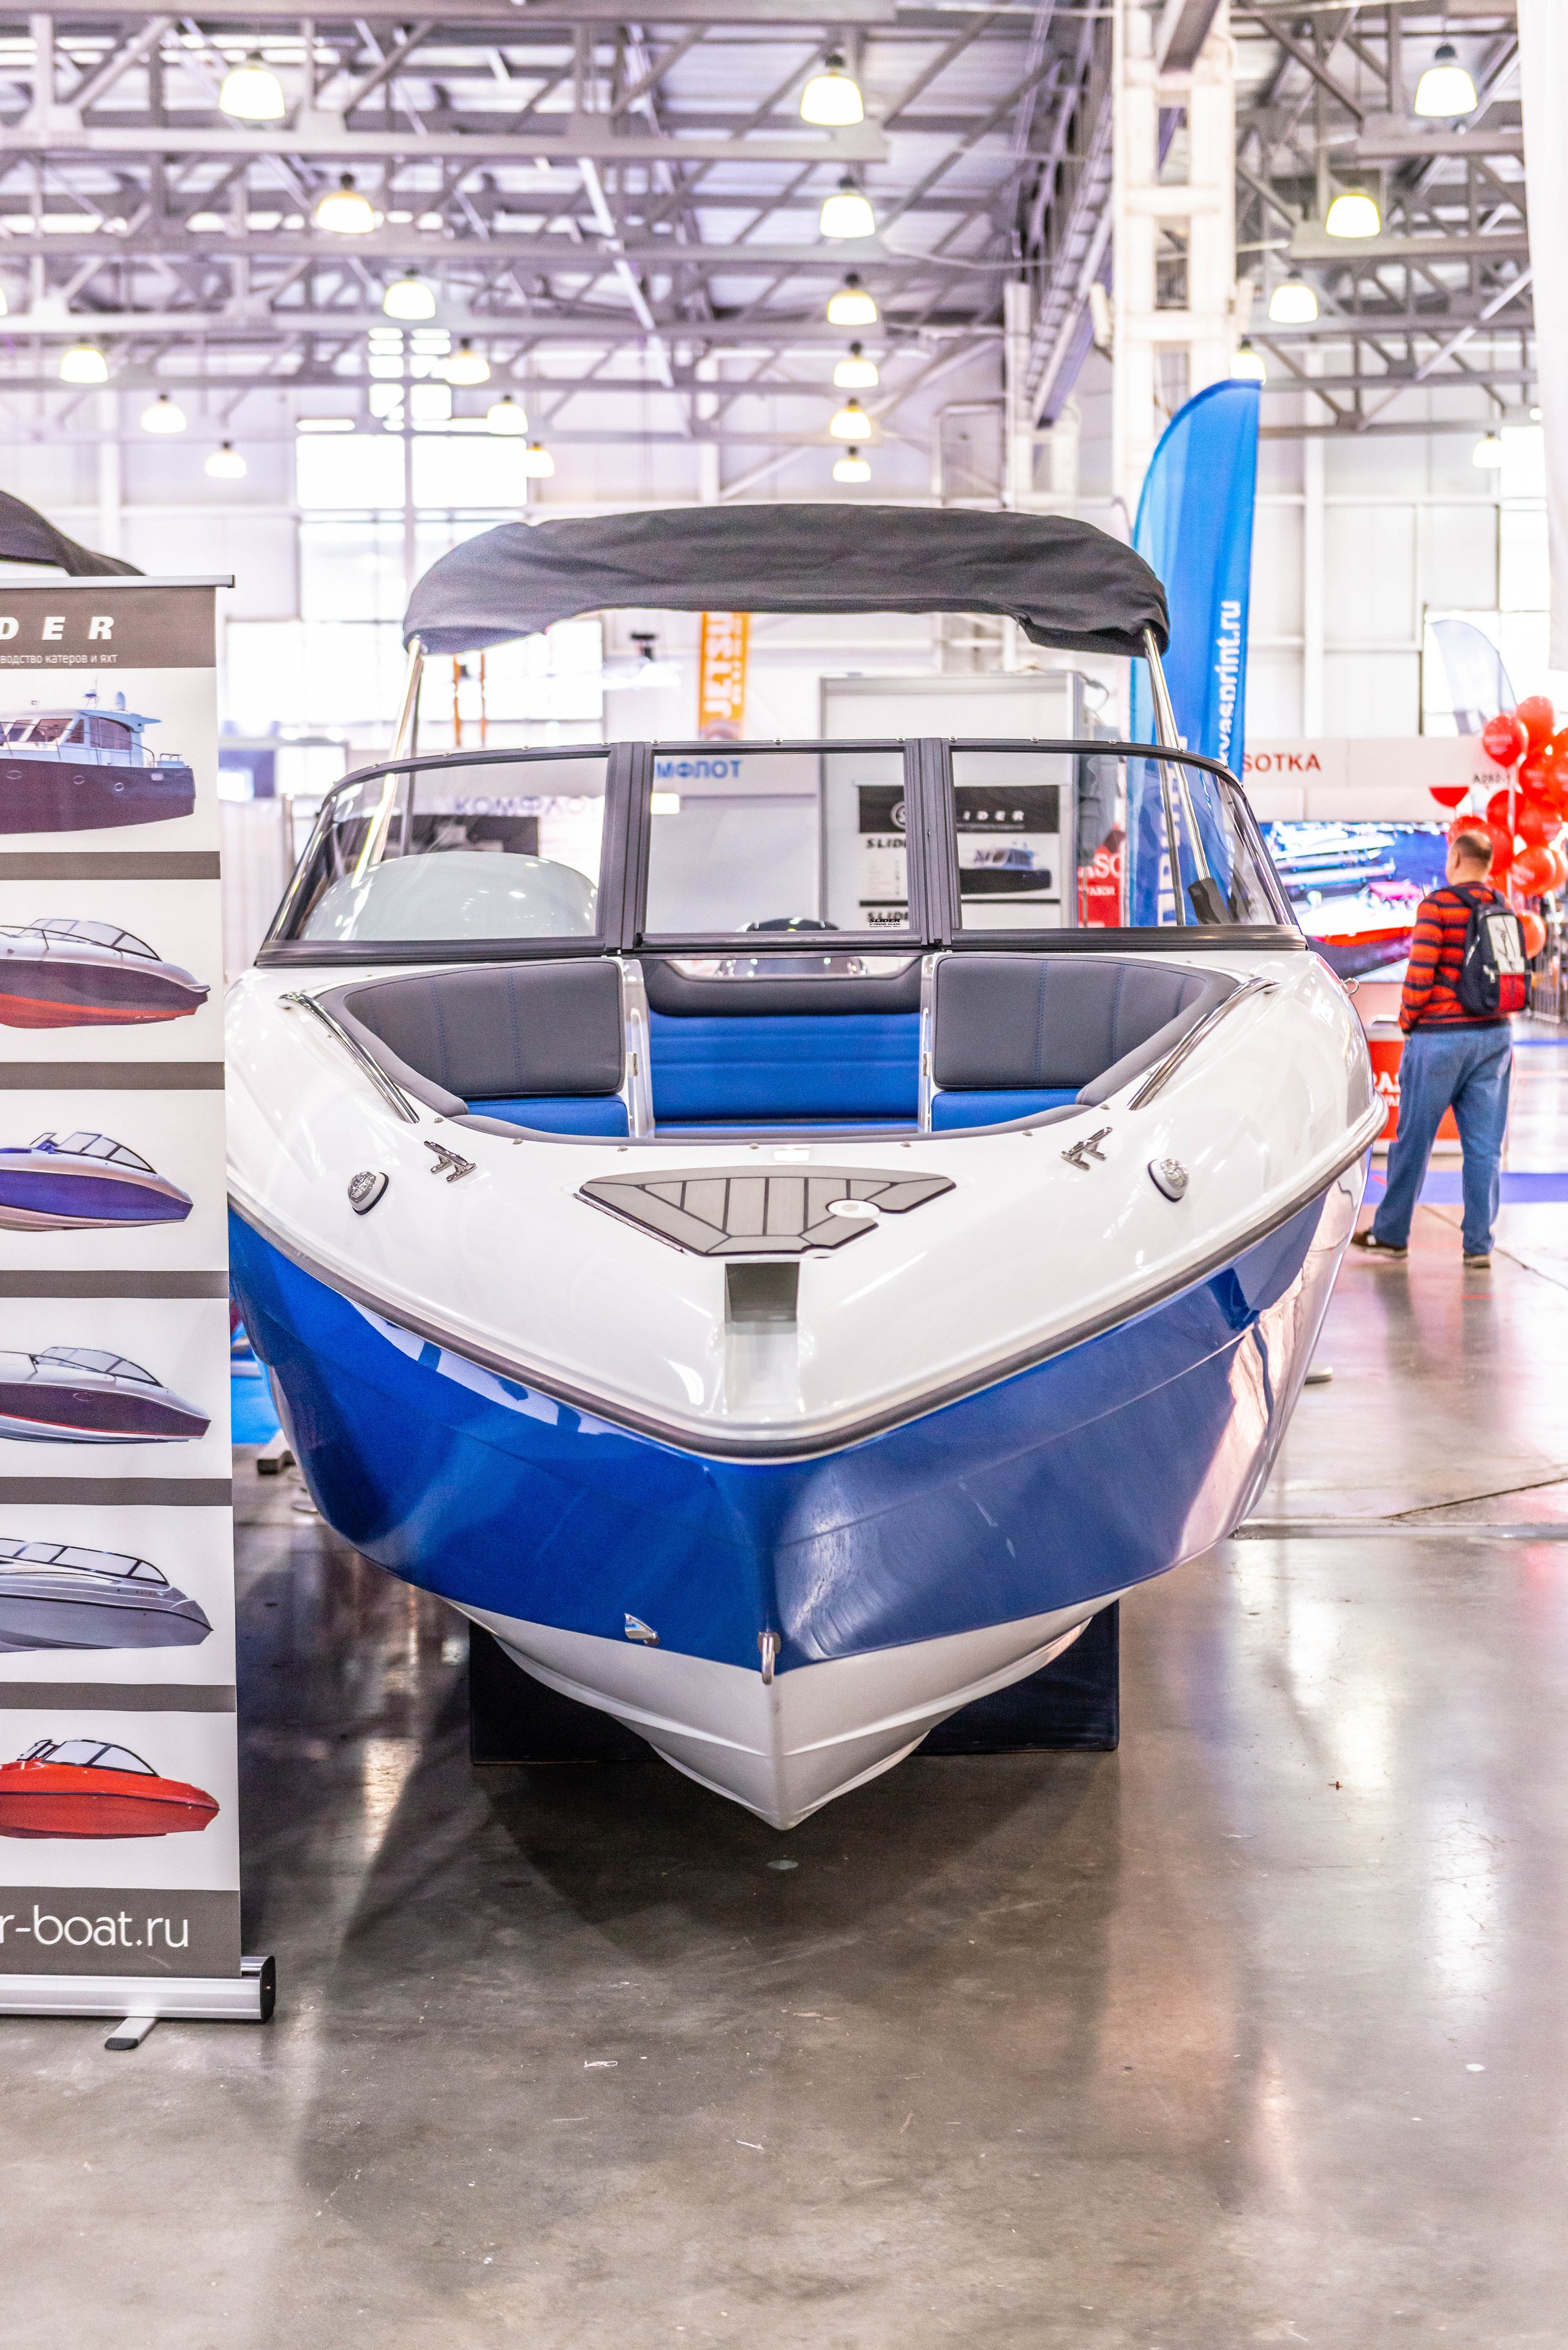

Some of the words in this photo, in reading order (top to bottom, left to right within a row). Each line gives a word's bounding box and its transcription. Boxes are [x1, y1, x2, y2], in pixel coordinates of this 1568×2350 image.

[0, 616, 115, 640] DER
[1, 654, 43, 665] водство
[45, 654, 88, 666] катеров
[91, 654, 97, 663] и
[100, 654, 118, 663] яхт
[0, 1904, 189, 1948] r-boat.ru
